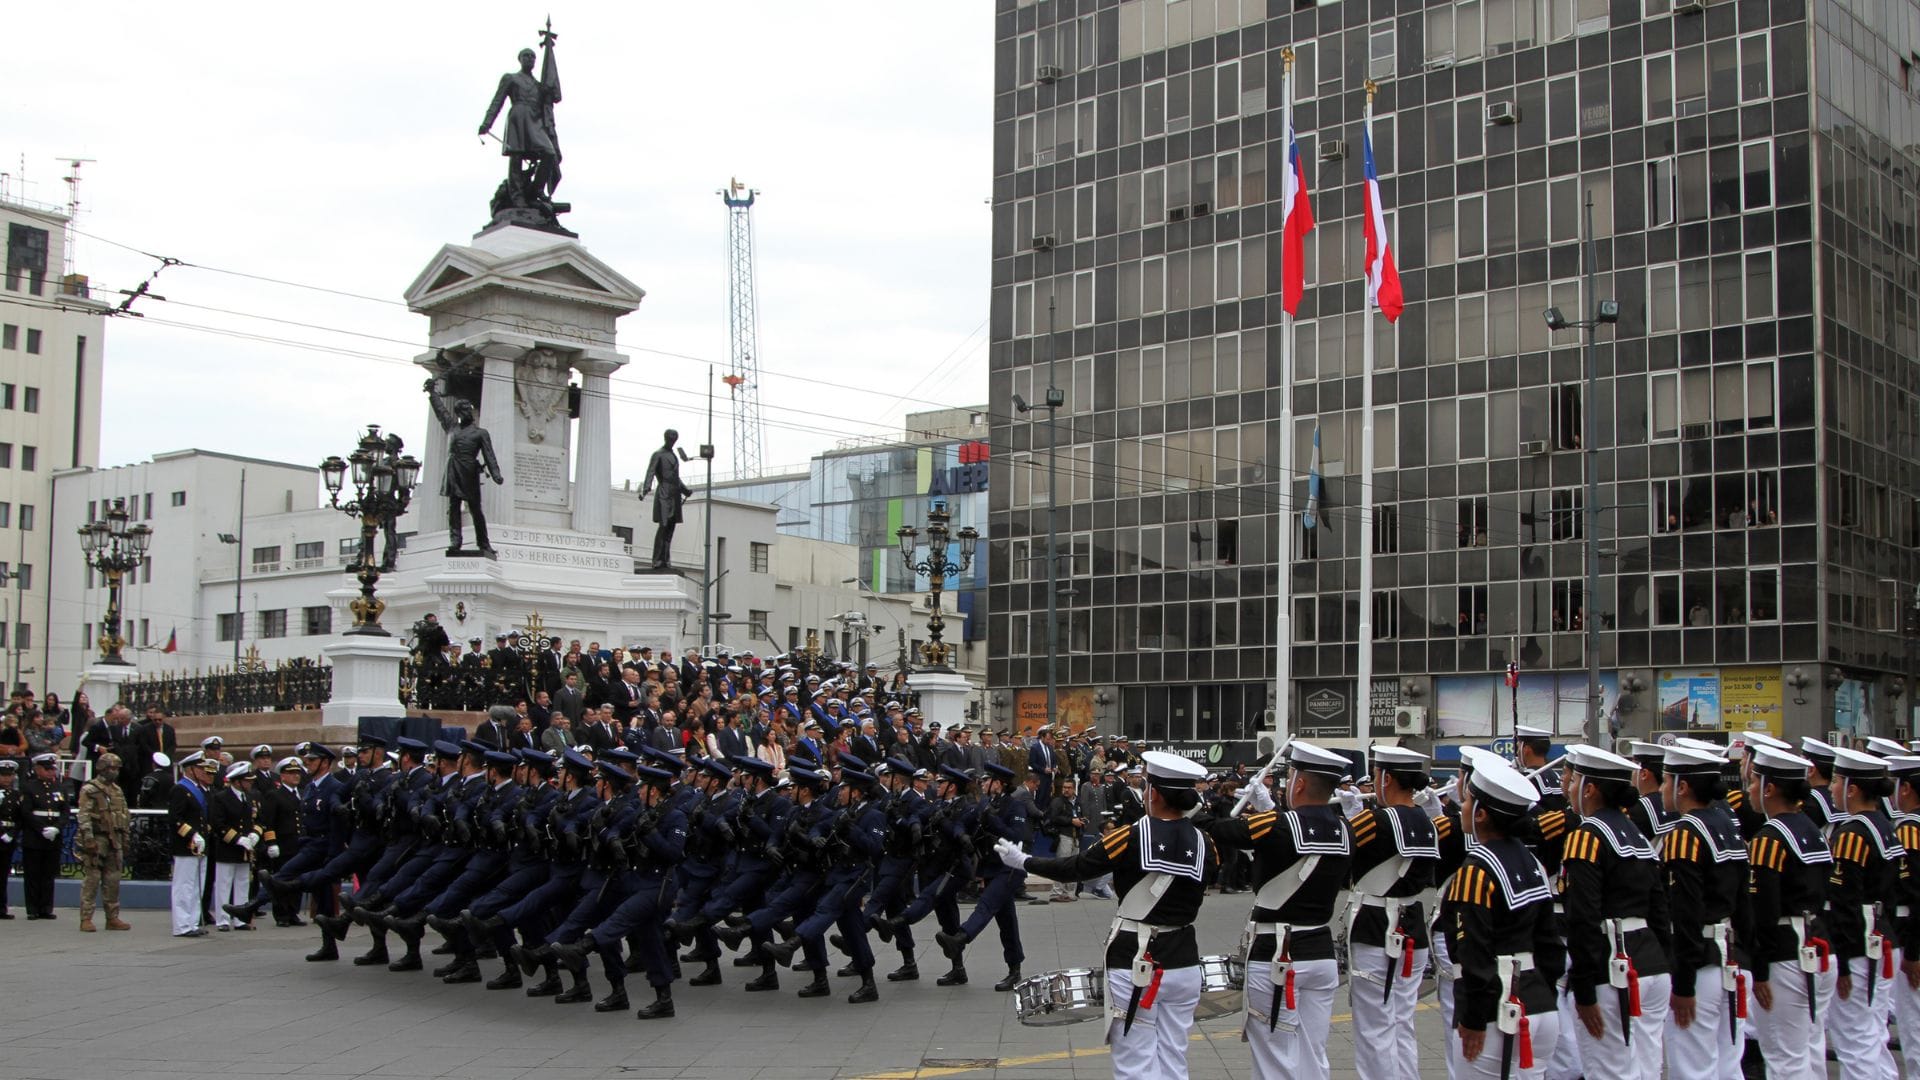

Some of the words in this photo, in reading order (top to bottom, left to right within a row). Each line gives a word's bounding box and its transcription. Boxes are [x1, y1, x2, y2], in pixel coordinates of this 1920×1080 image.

[928, 461, 988, 497] AIEP
[529, 532, 541, 543] DE
[546, 534, 571, 545] MAYO
[447, 560, 480, 570] SERRANO
[505, 549, 524, 560] SUS
[529, 551, 568, 564] HEROES
[572, 555, 620, 569] MARTYRES
[1025, 711, 1048, 719] Diner
[1153, 745, 1207, 759] Mlbourne
